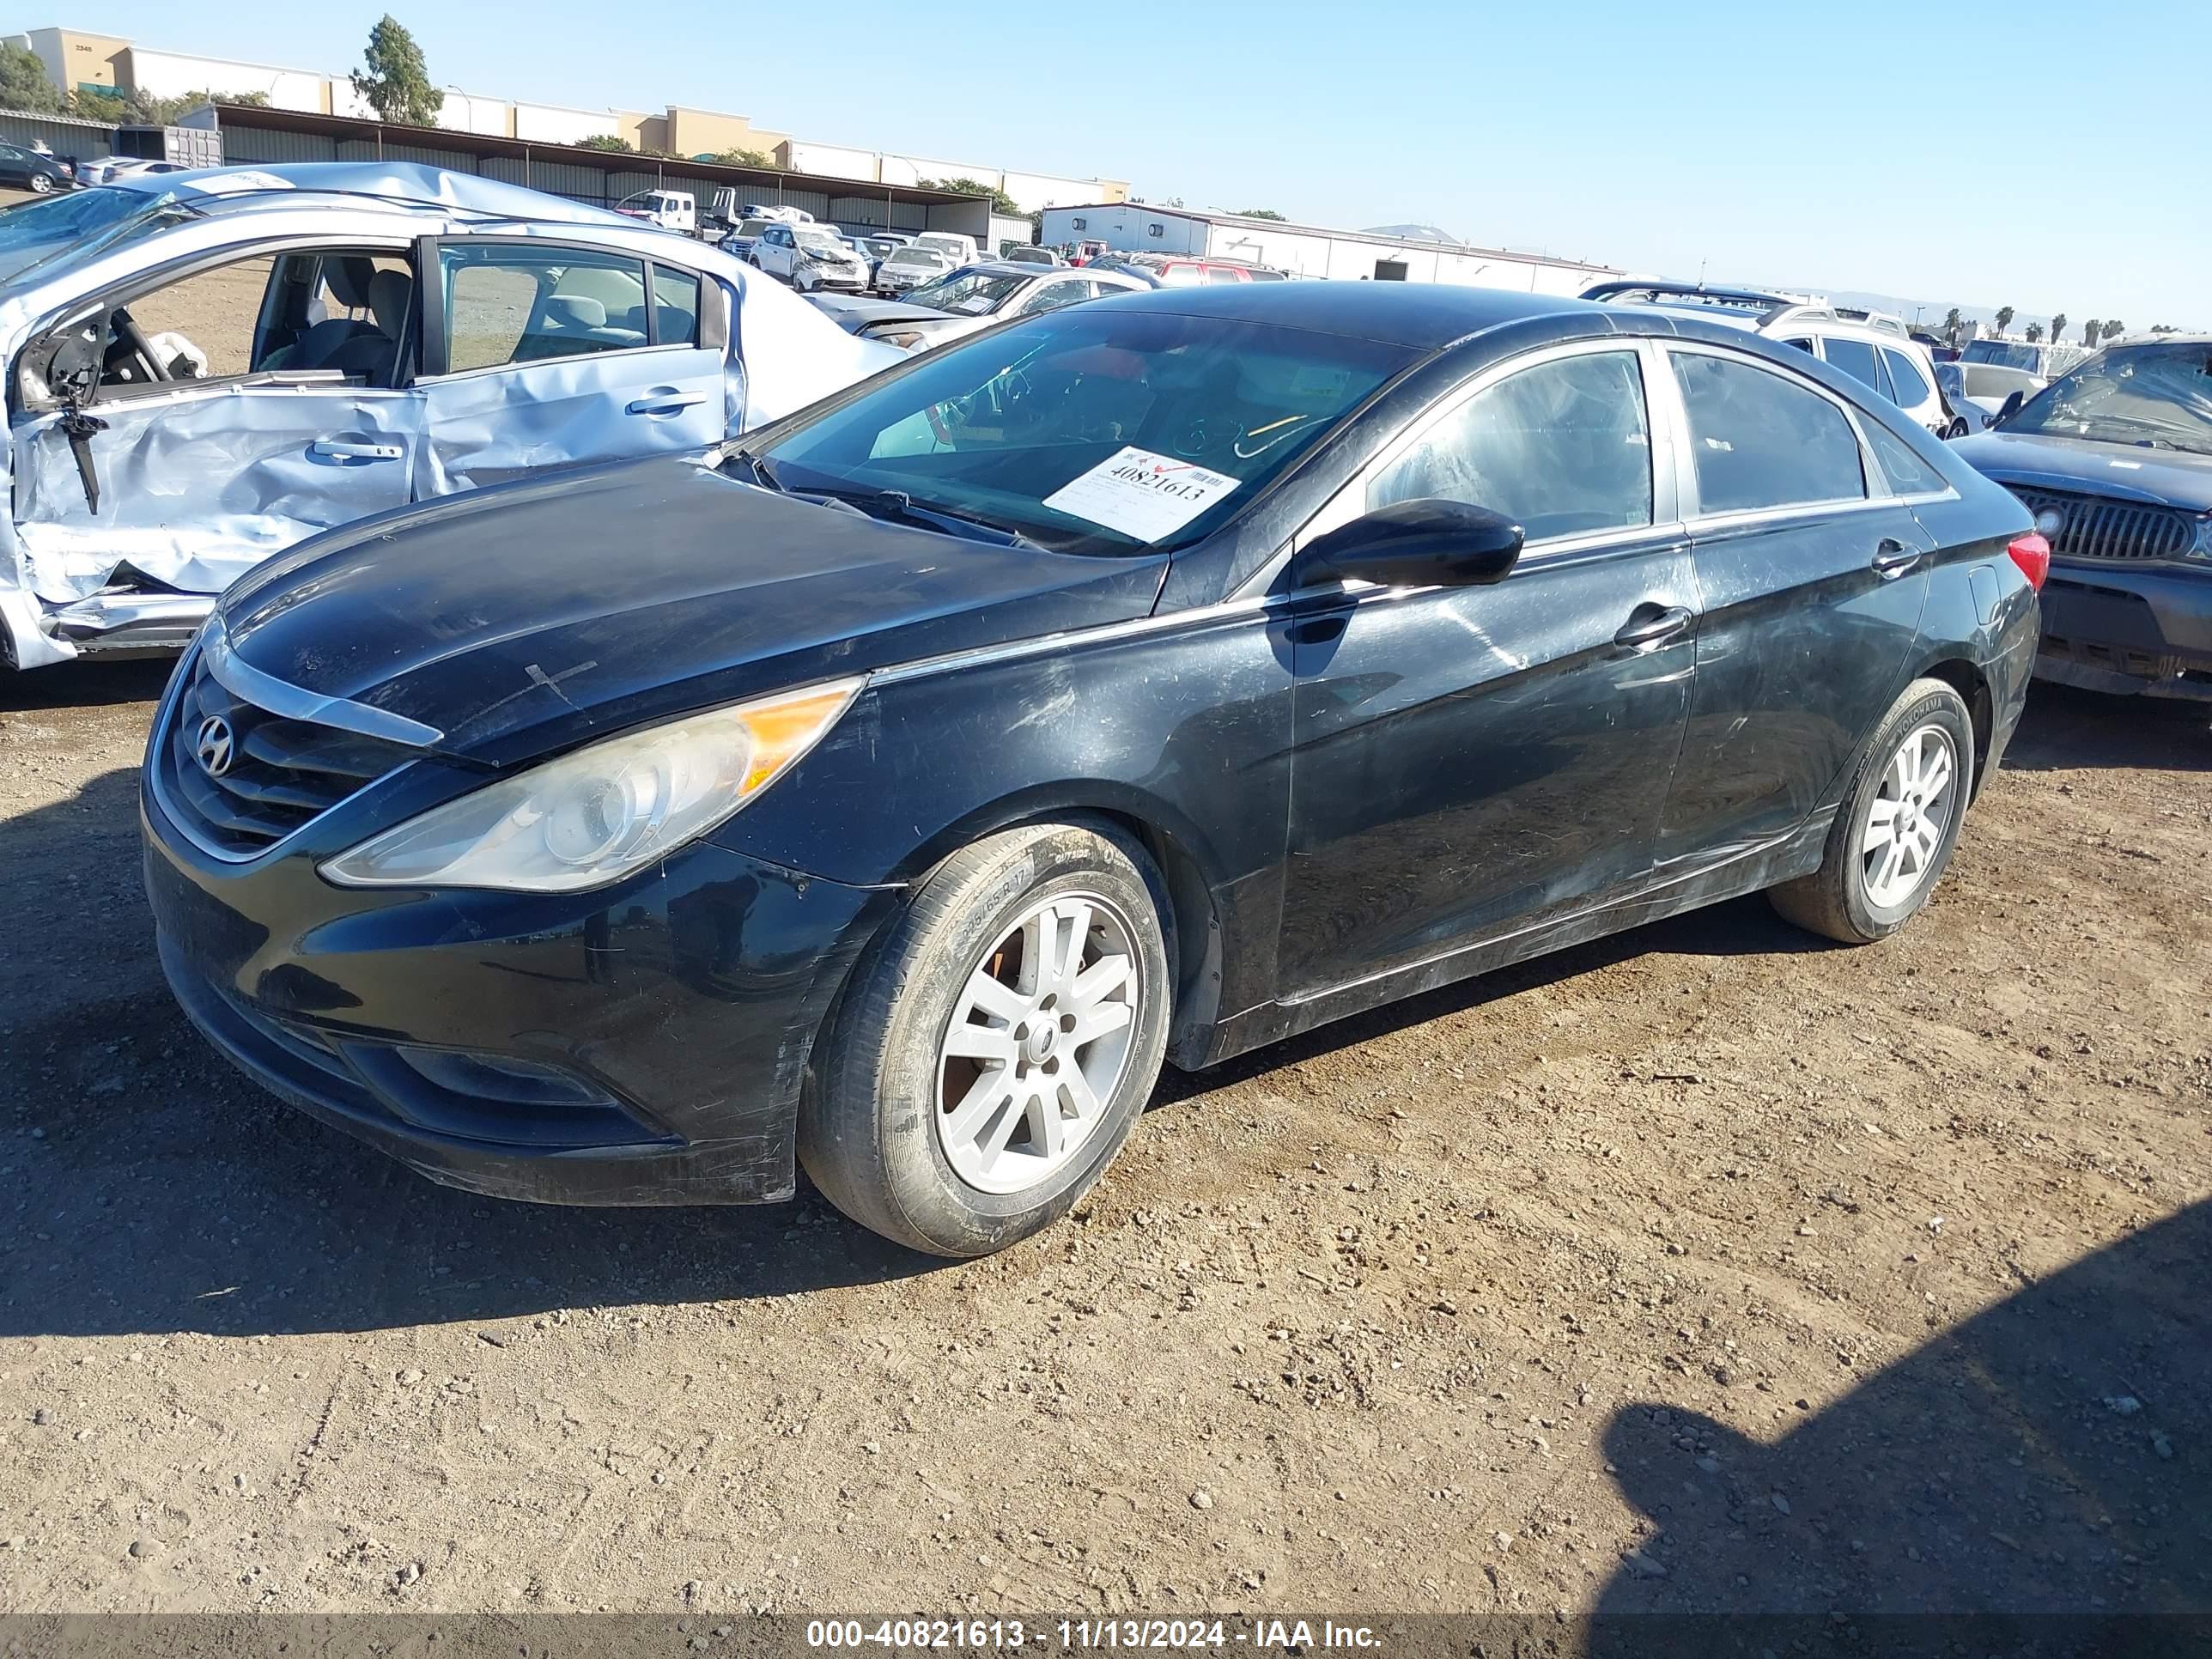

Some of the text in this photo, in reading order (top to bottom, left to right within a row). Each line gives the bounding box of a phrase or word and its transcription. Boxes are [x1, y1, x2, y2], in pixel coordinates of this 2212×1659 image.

[1109, 465, 1206, 501] 40821613
[1897, 697, 1942, 737] YOKOHAMA
[1056, 849, 1089, 864] OUTSIDE
[963, 869, 1025, 940] 225/65 R 17
